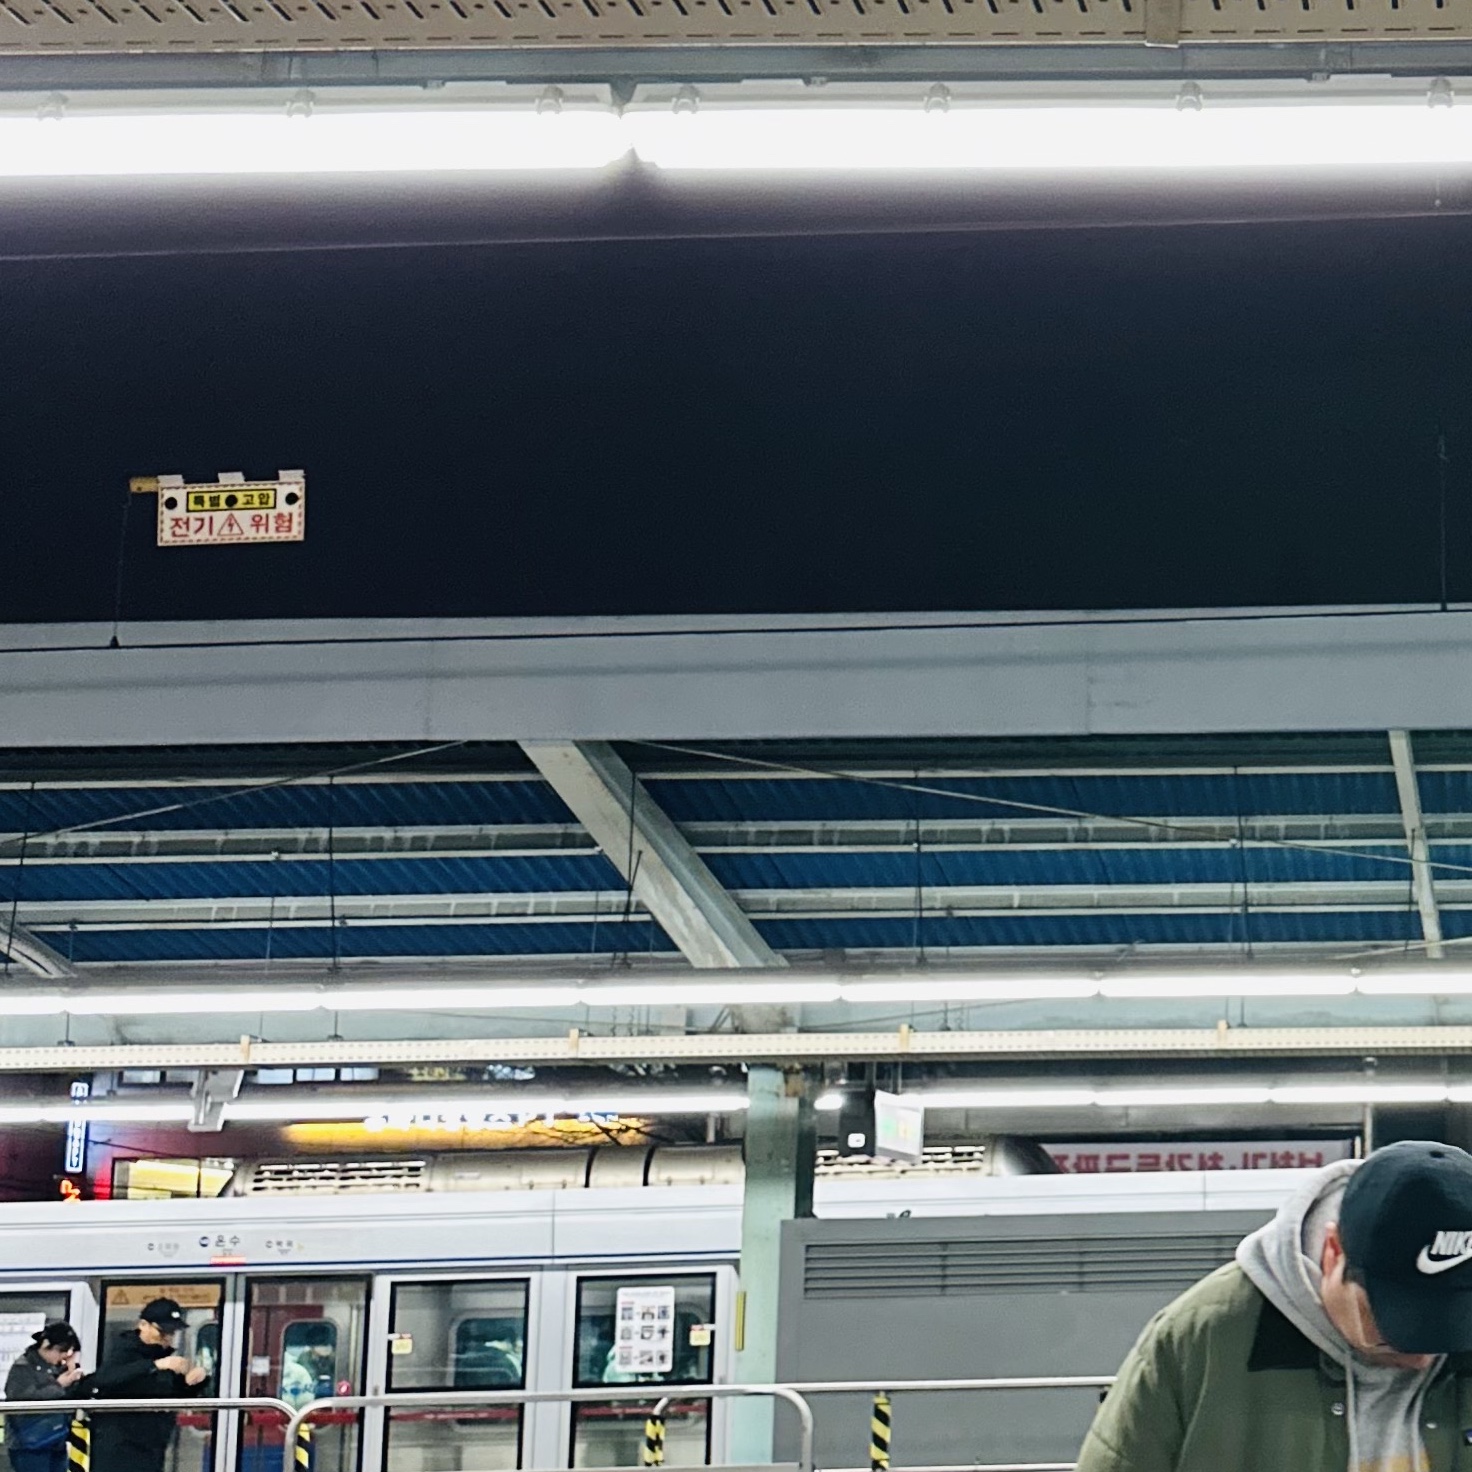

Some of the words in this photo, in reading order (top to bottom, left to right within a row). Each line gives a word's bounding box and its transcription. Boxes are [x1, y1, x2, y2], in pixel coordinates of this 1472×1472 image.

[192, 493, 221, 508] 특별
[242, 492, 271, 507] 고압
[169, 515, 214, 538] 전기
[250, 512, 293, 534] 위험
